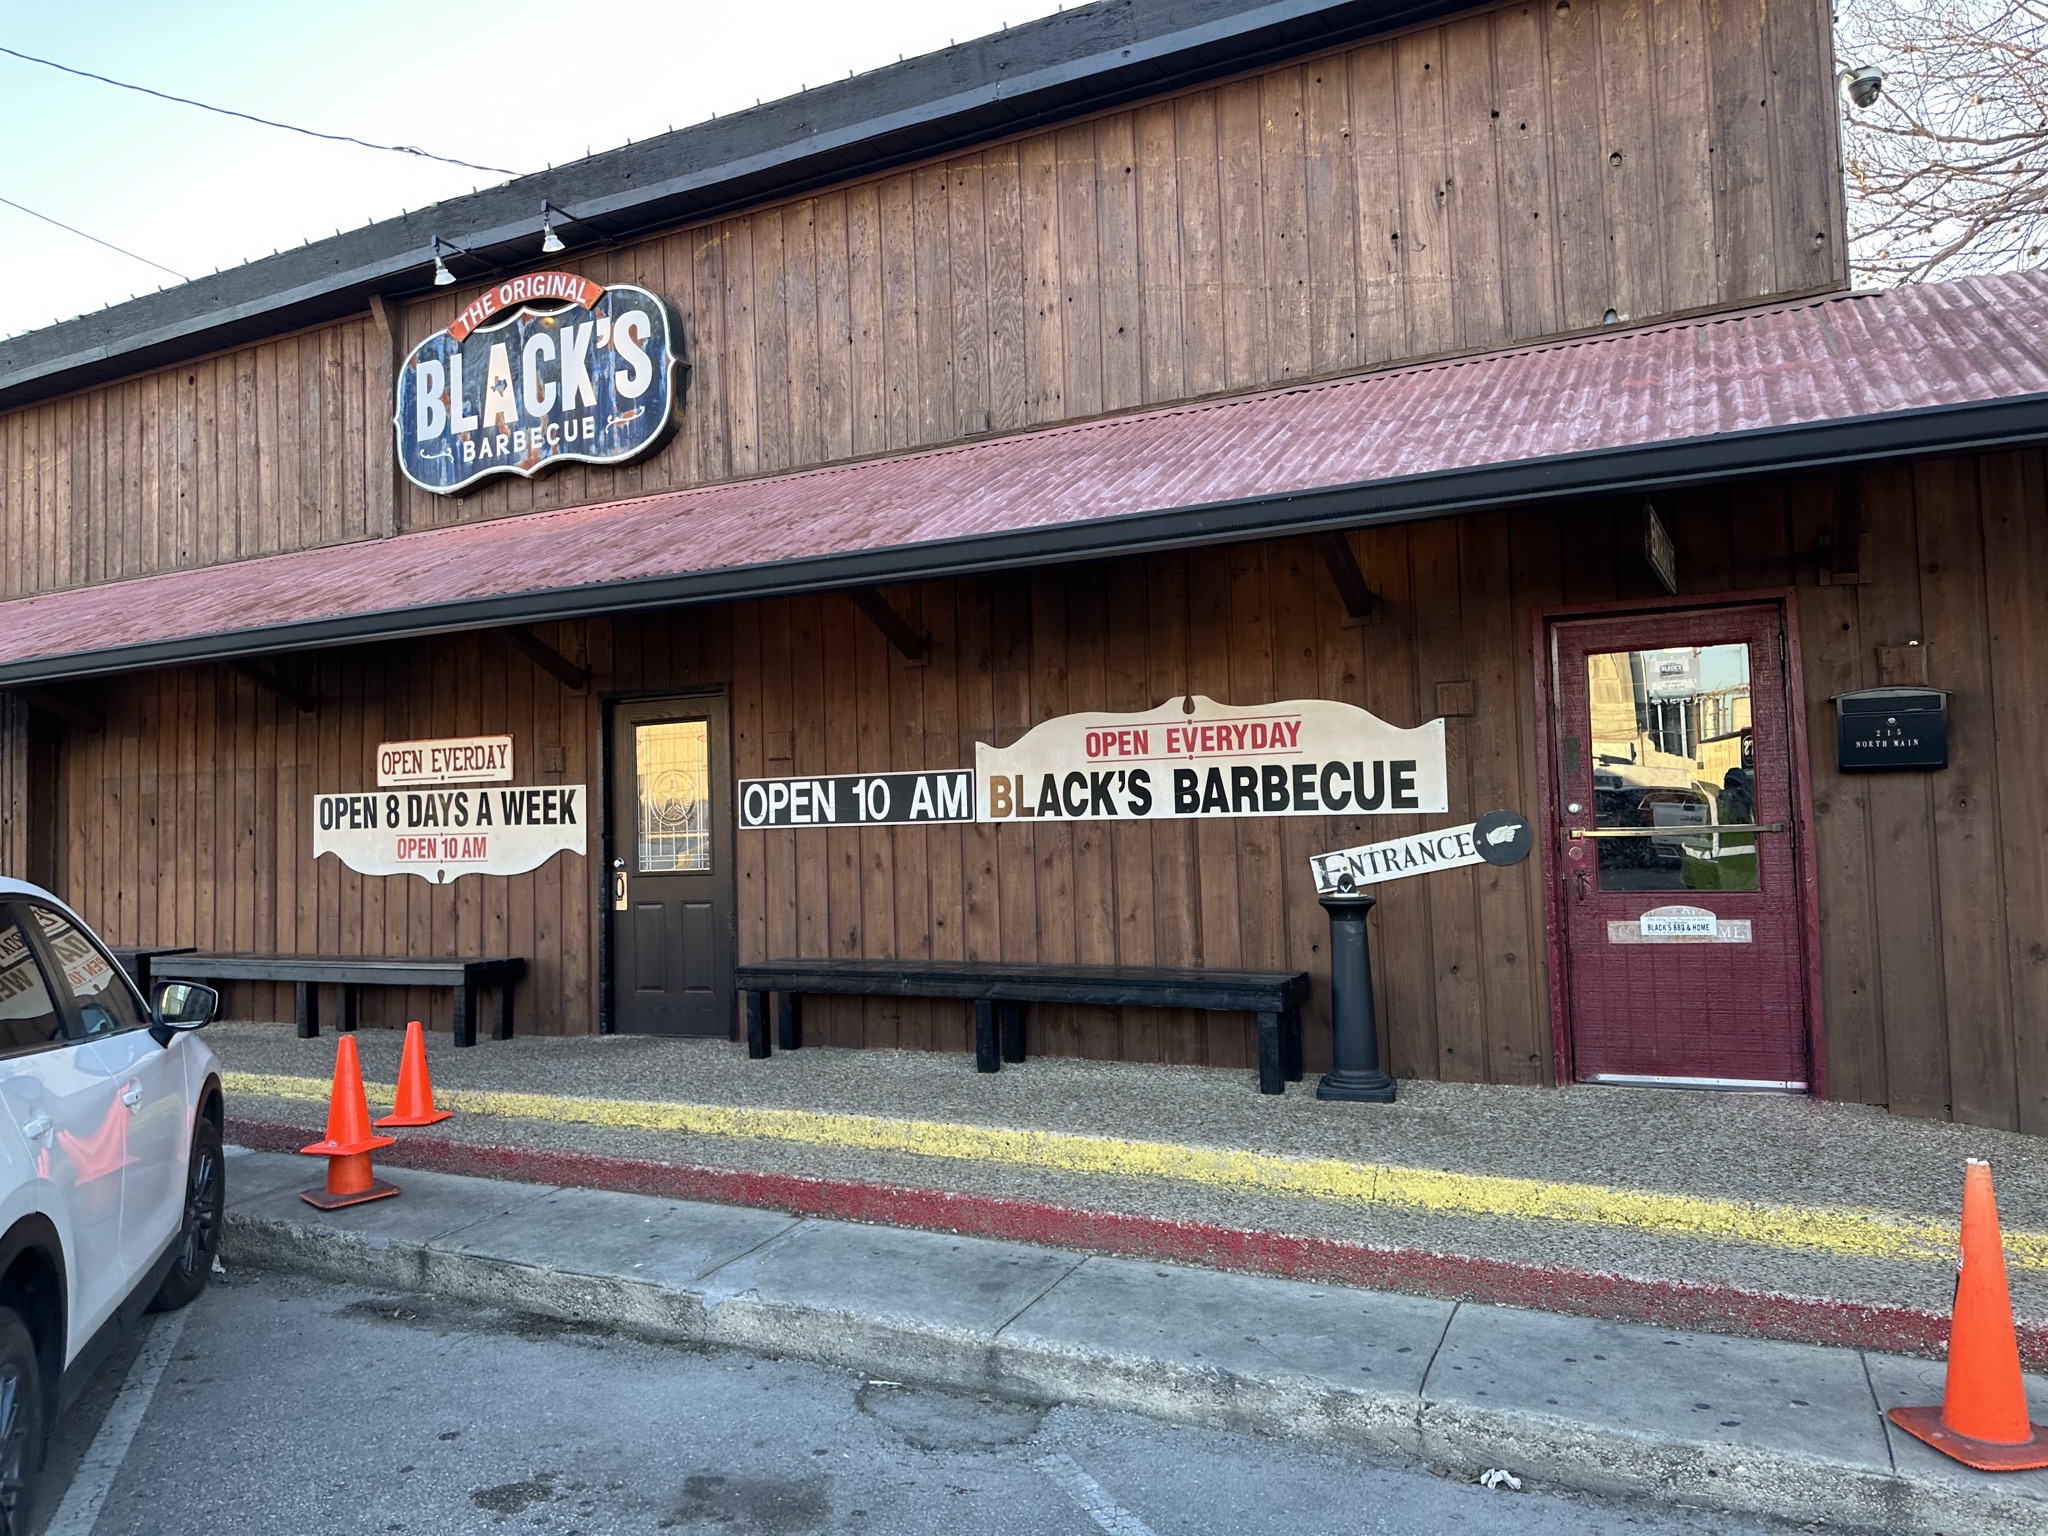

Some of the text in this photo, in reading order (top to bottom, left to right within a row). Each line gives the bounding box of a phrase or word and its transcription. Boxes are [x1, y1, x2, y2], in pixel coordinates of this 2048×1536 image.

[458, 274, 587, 333] THE ORIGINAL
[416, 310, 652, 442] BLACK'S
[463, 416, 596, 462] BARBECUE
[382, 744, 508, 776] OPEN EVERDAY
[1085, 720, 1302, 758] OPEN EVERYDAY
[1856, 739, 1919, 748] NORTH MAIN
[319, 789, 577, 831] OPEN 8 DAYS A WEEK
[743, 774, 968, 826] OPEN 10 AM
[989, 759, 1419, 818] BLACK'S BARBECUE
[397, 836, 487, 859] OPEN 10 AM
[1311, 832, 1476, 891] ENTRANCE
[1673, 923, 1685, 931] BBQ
[1692, 923, 1710, 931] HOME
